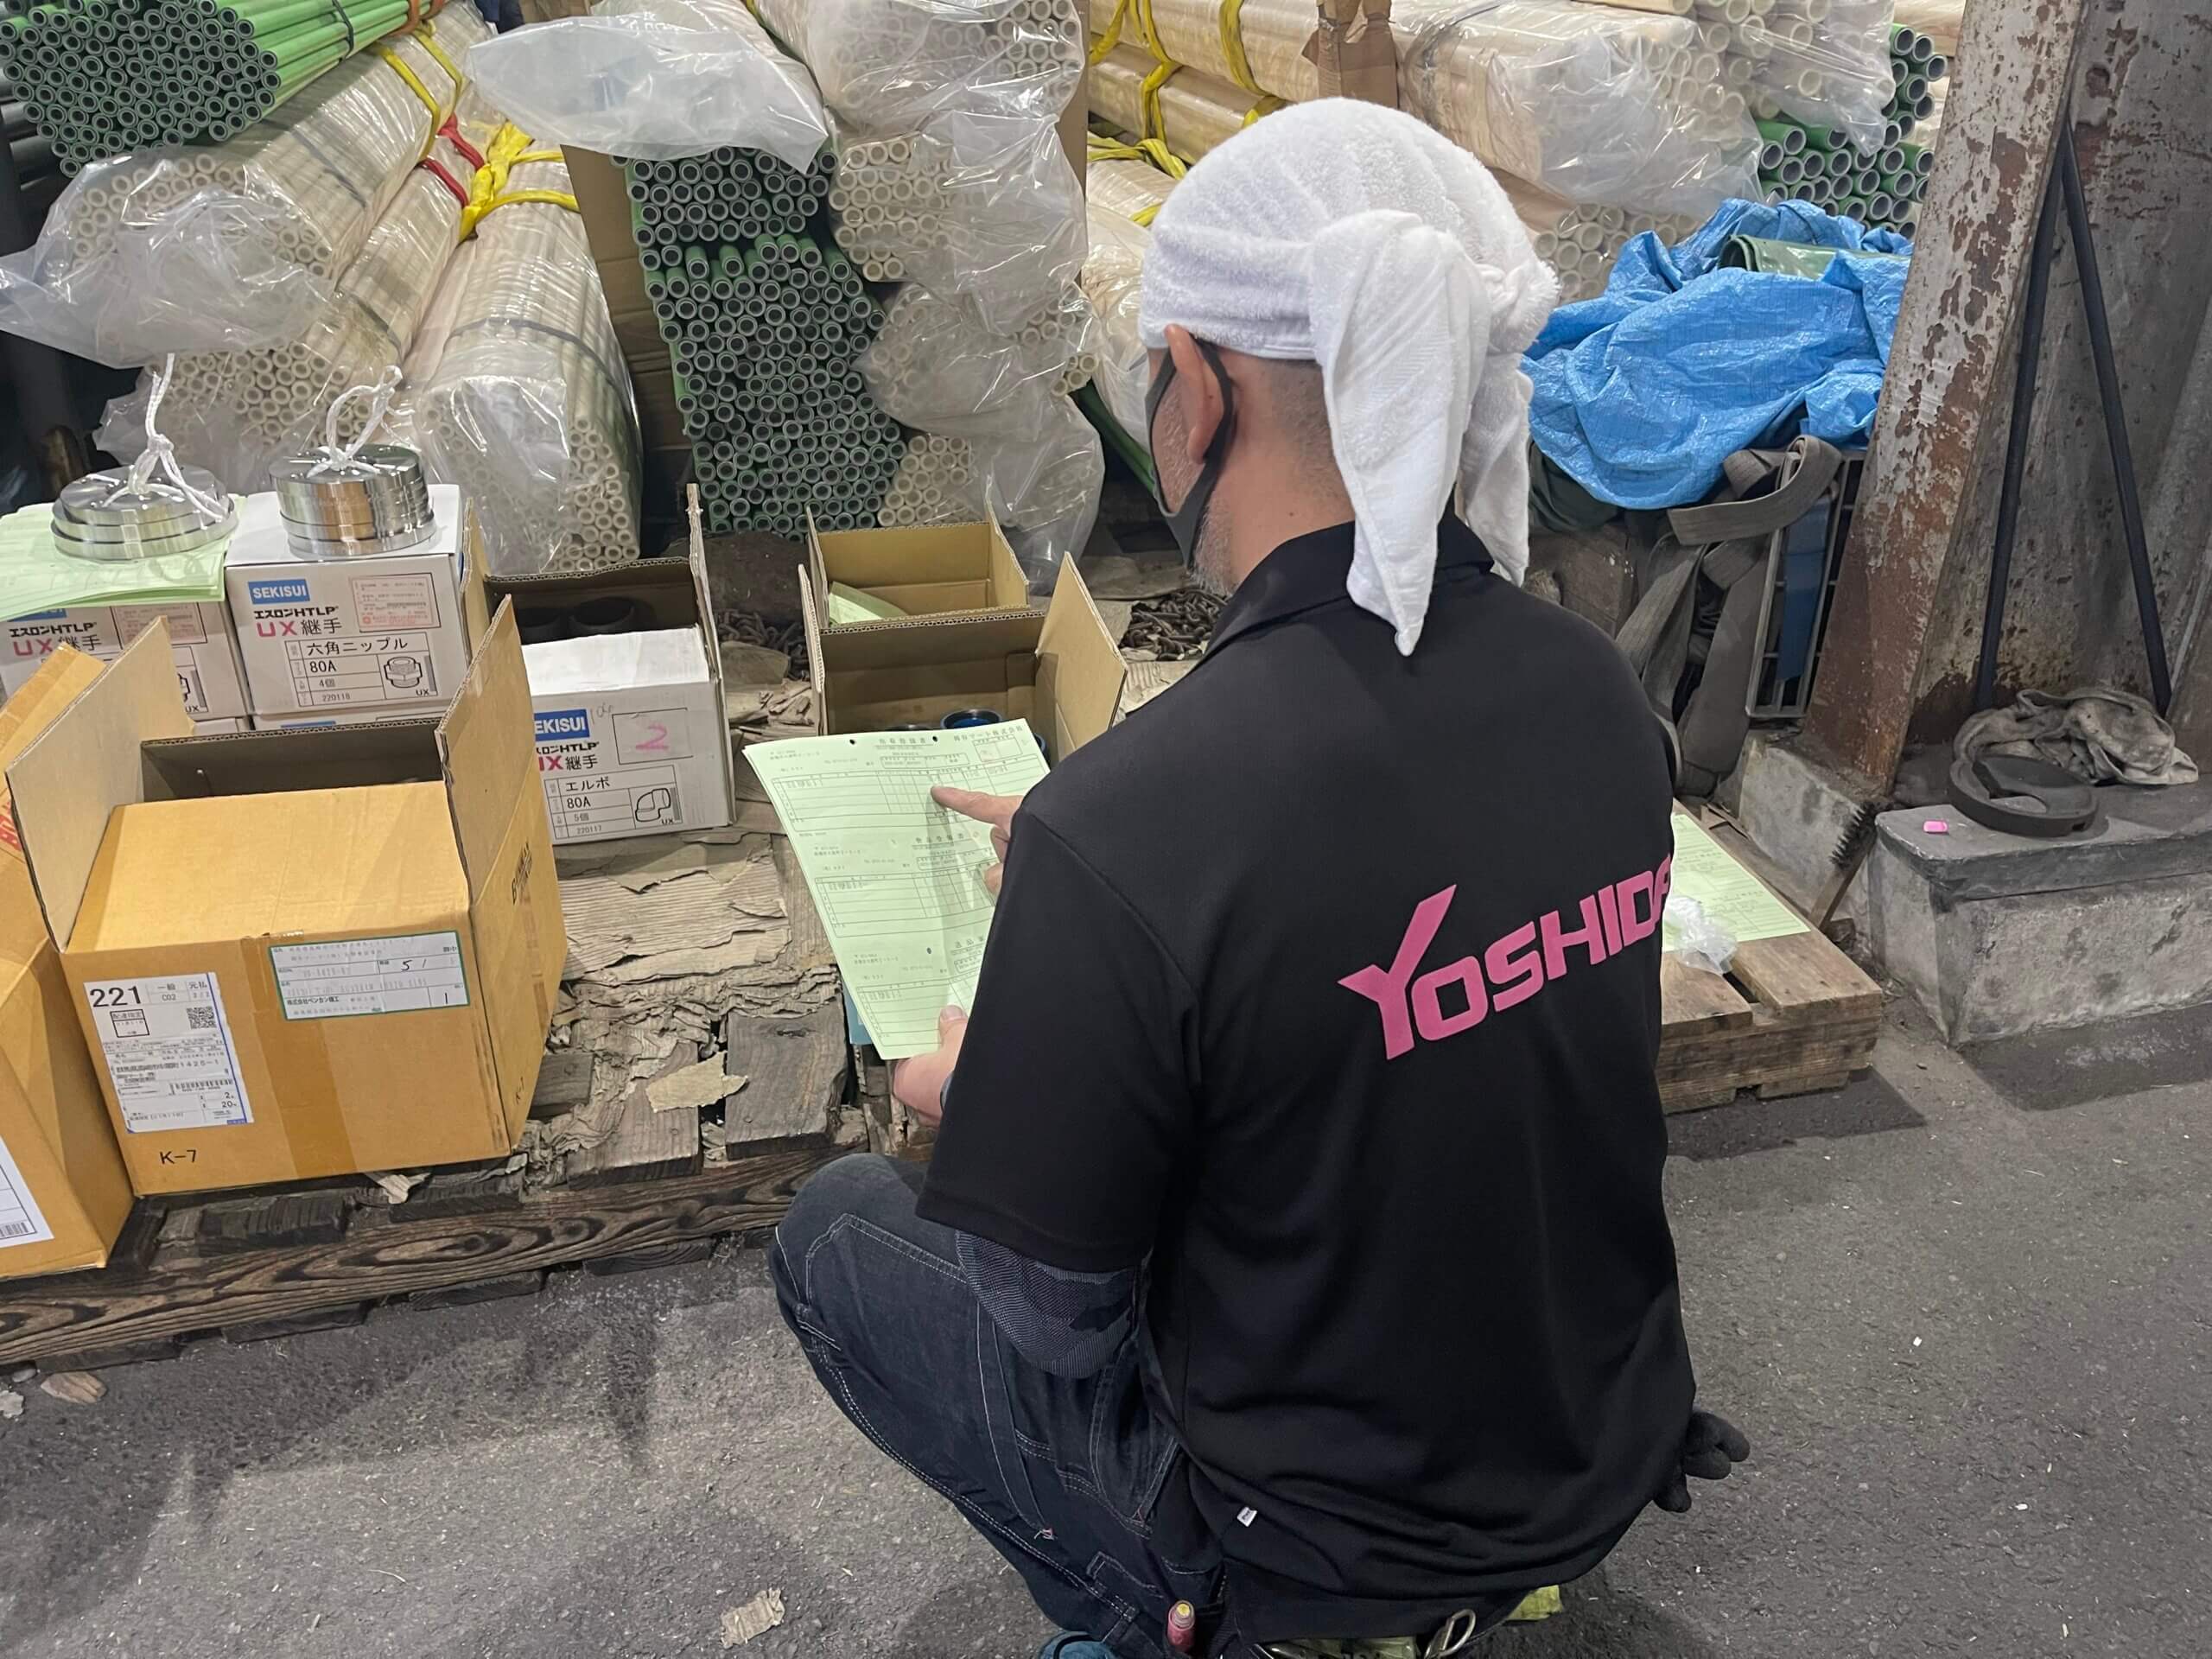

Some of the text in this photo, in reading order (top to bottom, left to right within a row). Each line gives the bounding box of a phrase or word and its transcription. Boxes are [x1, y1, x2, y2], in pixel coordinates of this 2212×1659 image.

[251, 585, 308, 600] SEKISUI
[307, 637, 409, 656] 六角ニップル
[309, 660, 337, 673] 80A
[535, 716, 586, 734] EKISUI
[636, 721, 670, 751] 2
[536, 742, 600, 755] ロンHTLP
[567, 797, 592, 809] 80A
[89, 986, 142, 1007] 221
[159, 1149, 197, 1165] K-7
